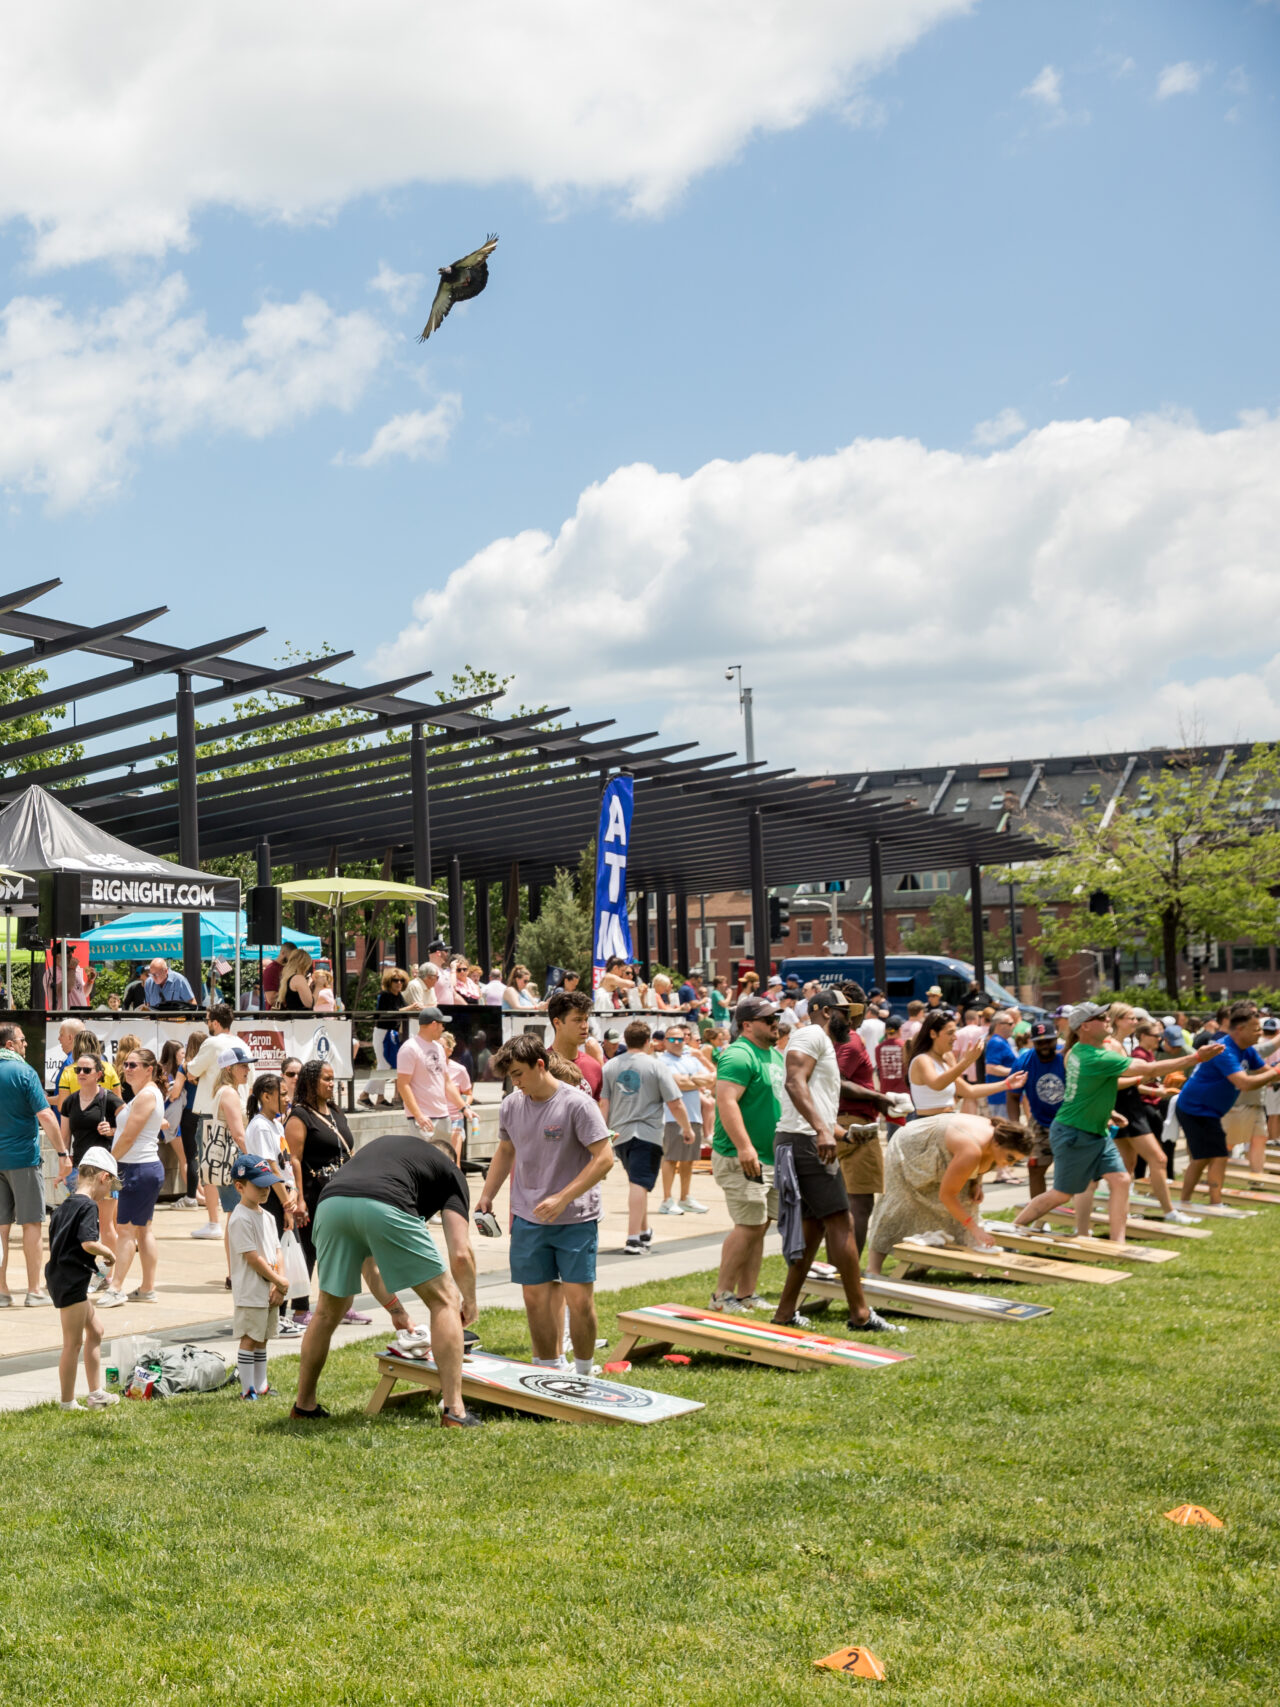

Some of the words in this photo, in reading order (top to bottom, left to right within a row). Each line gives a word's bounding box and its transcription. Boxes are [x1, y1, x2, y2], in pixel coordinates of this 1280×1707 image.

[596, 794, 629, 960] ATM
[91, 879, 216, 906] BIGNIGHT.COM
[842, 1651, 859, 1671] 2
